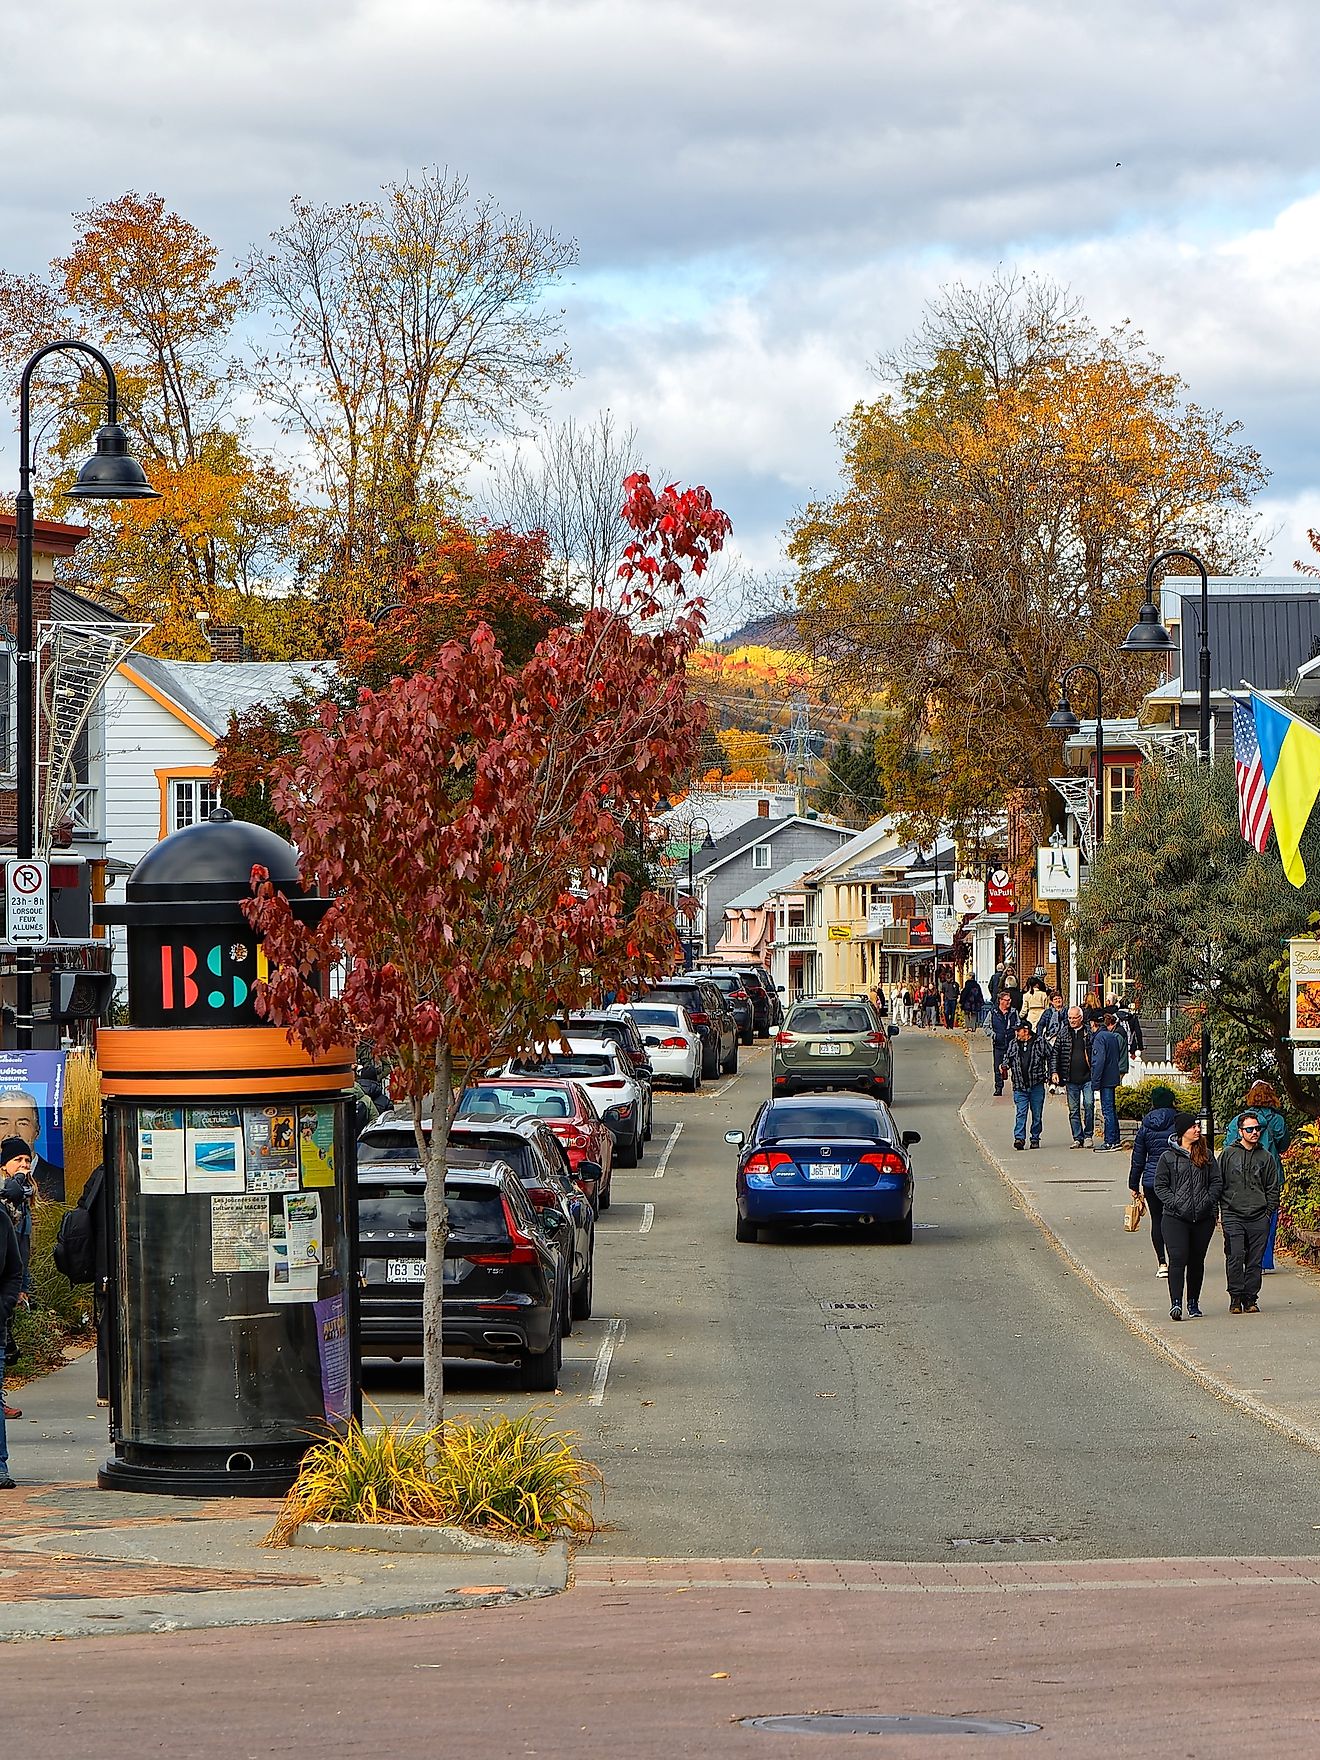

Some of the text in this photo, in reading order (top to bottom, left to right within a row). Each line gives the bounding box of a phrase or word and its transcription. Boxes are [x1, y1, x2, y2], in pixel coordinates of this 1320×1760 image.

[12, 907, 43, 915] LORSQUE
[19, 915, 37, 923] FEUX
[12, 922, 44, 931] ALLUMÉS
[0, 1067, 28, 1075] uébec
[810, 1167, 825, 1177] J65
[388, 1263, 408, 1276] Y63
